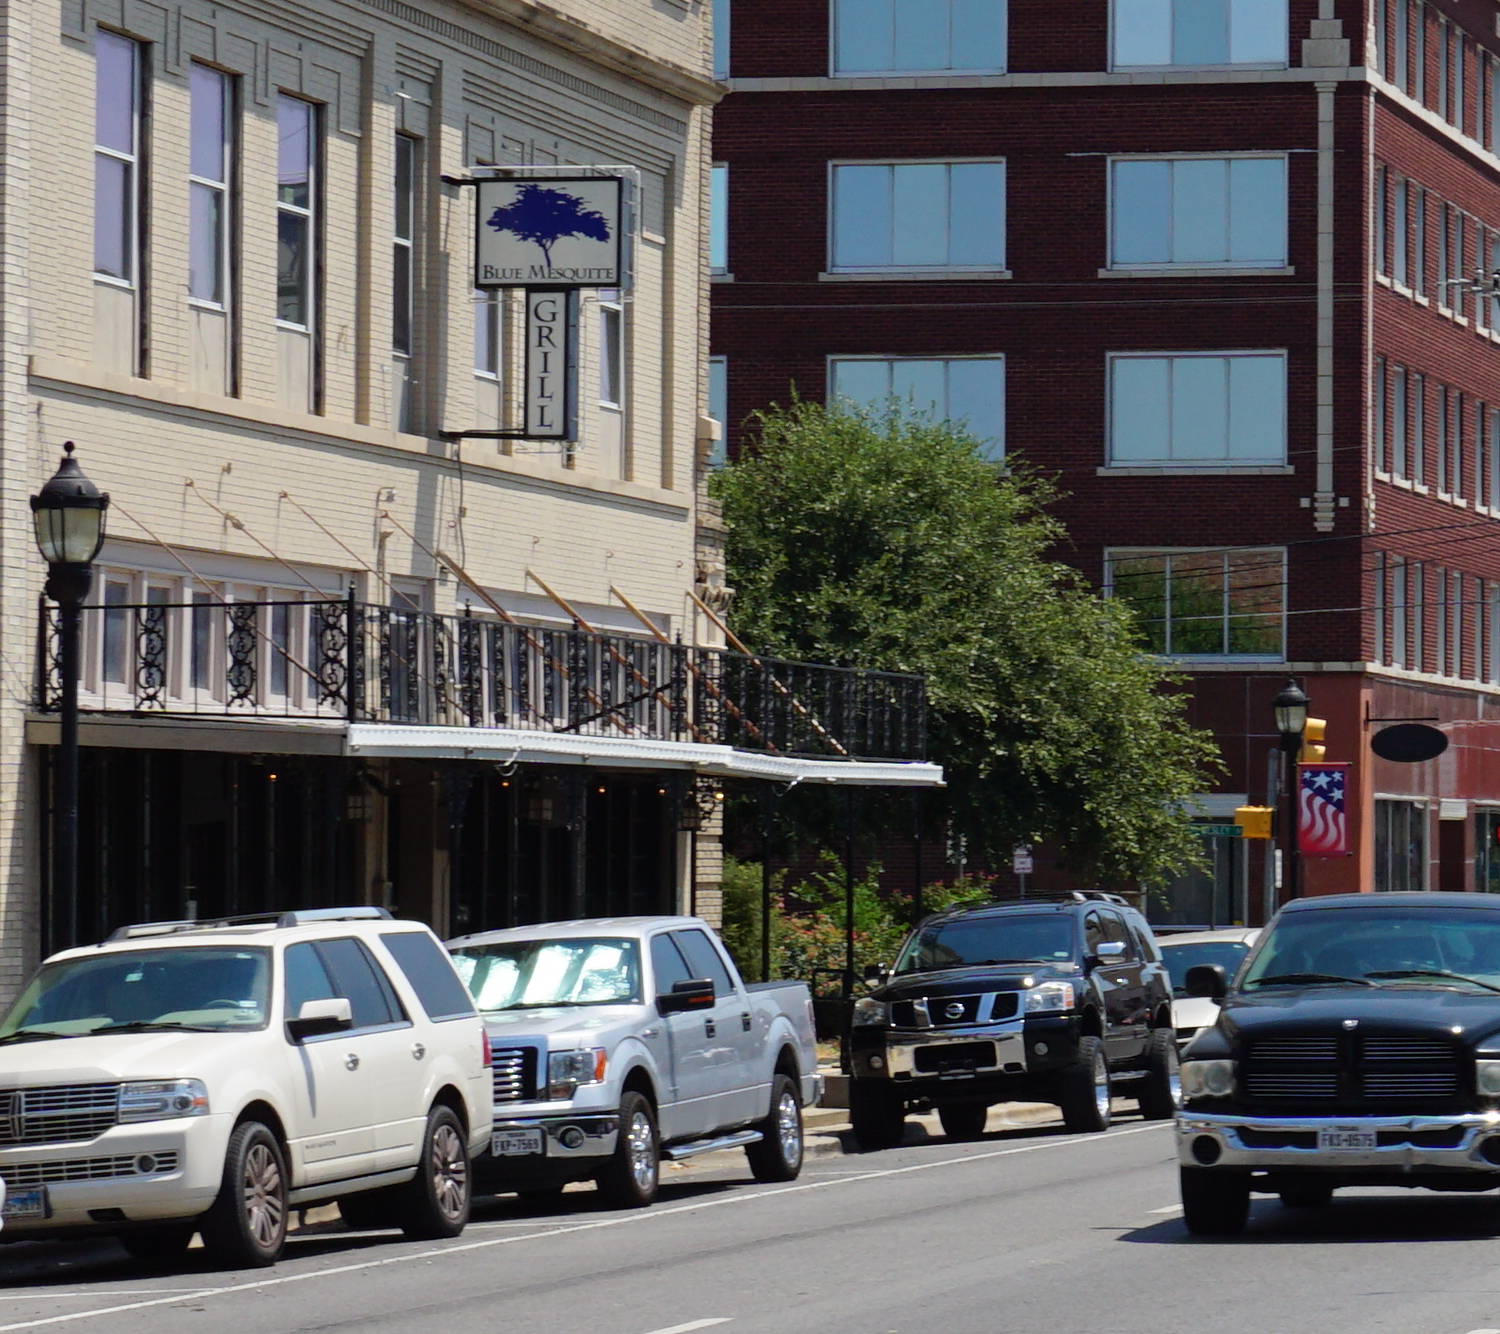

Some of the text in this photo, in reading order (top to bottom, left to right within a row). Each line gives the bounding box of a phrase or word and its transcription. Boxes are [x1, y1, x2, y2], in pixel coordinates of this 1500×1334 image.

[483, 264, 615, 282] BLUE MESQUITE
[533, 299, 560, 430] GRILL
